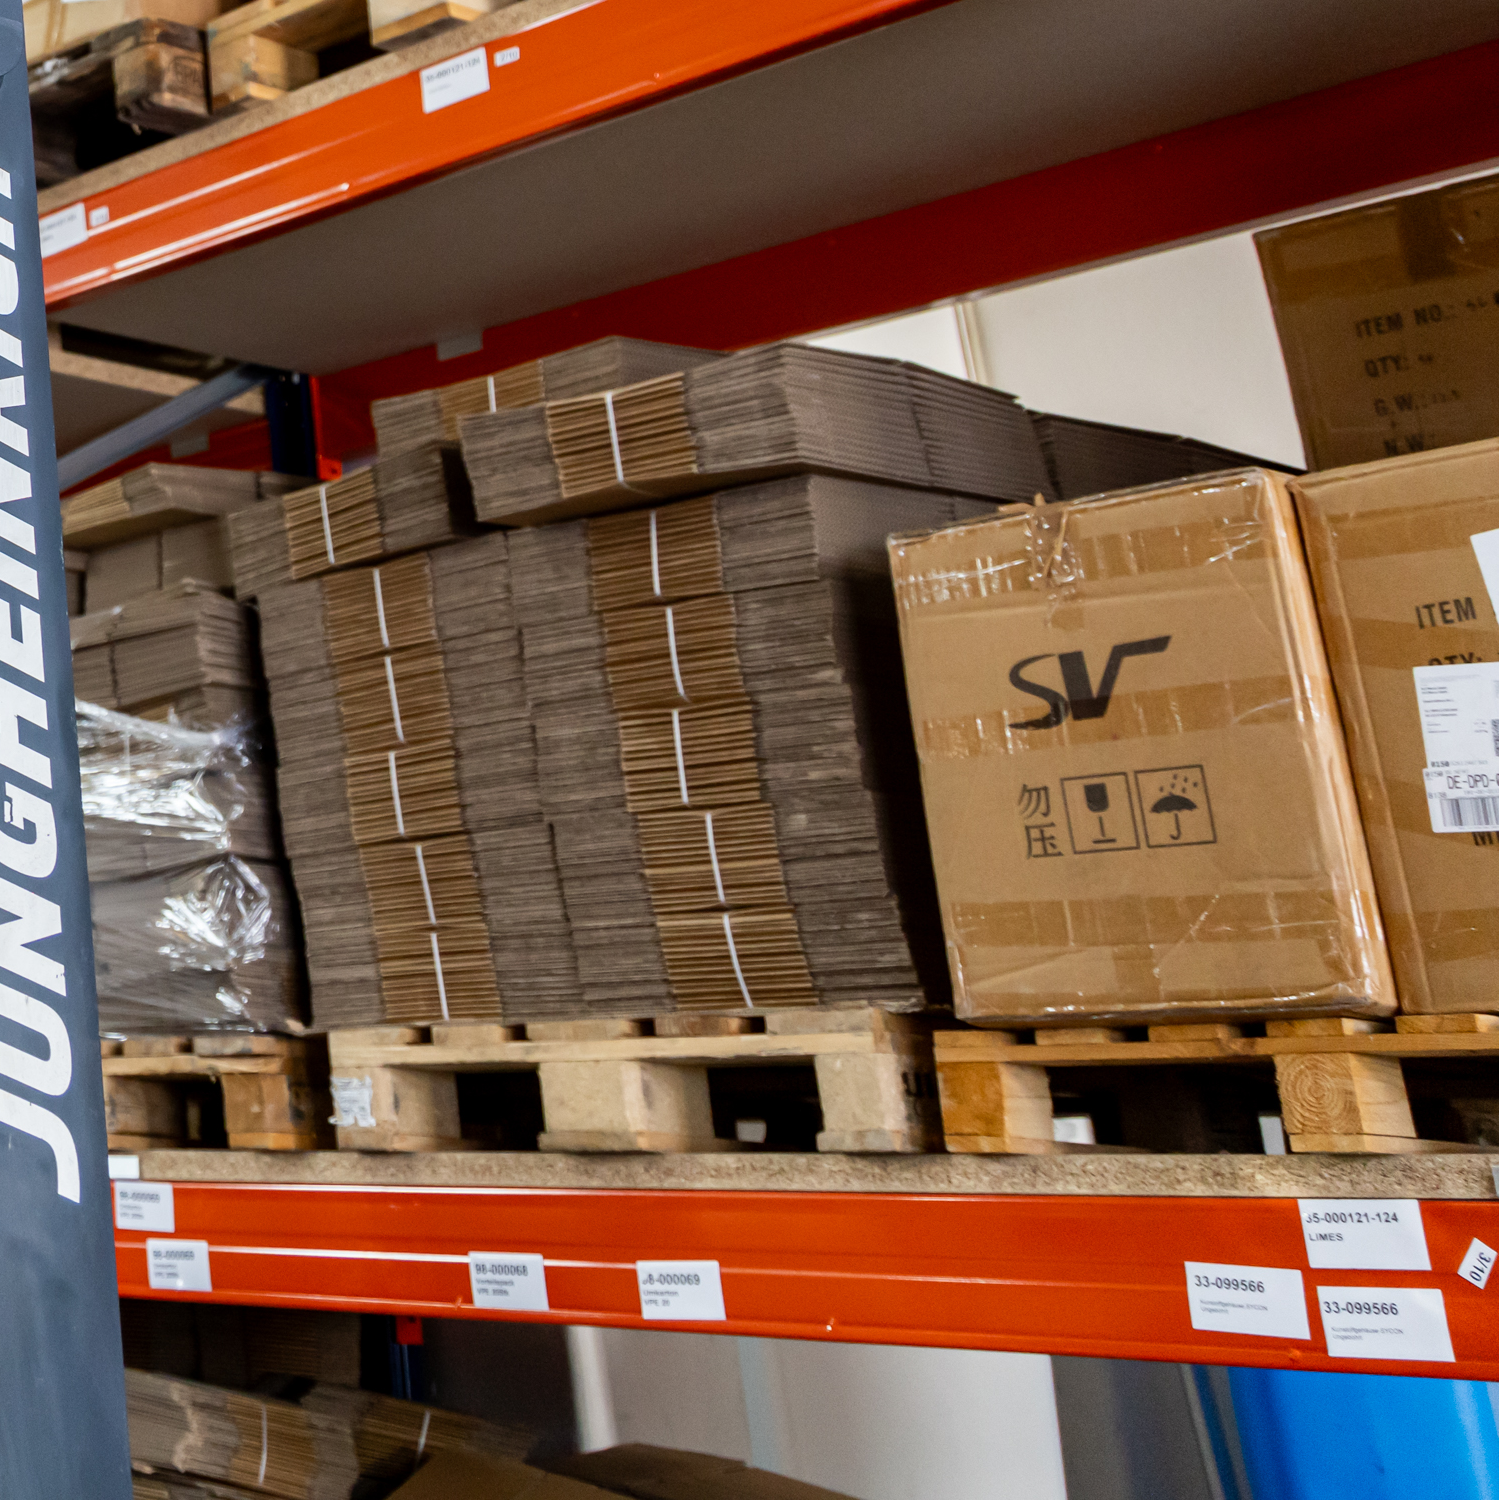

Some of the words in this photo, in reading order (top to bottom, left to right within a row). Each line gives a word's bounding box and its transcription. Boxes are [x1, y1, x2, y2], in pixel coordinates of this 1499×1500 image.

[1415, 596, 1477, 630] ITEM
[1007, 635, 1172, 730] SV
[1017, 783, 1064, 860] 勿压
[1308, 1233, 1344, 1242] LIMES
[1469, 1251, 1492, 1282] 3/10
[1194, 1274, 1266, 1293] 33-099566
[1323, 1301, 1399, 1316] 33-099566
